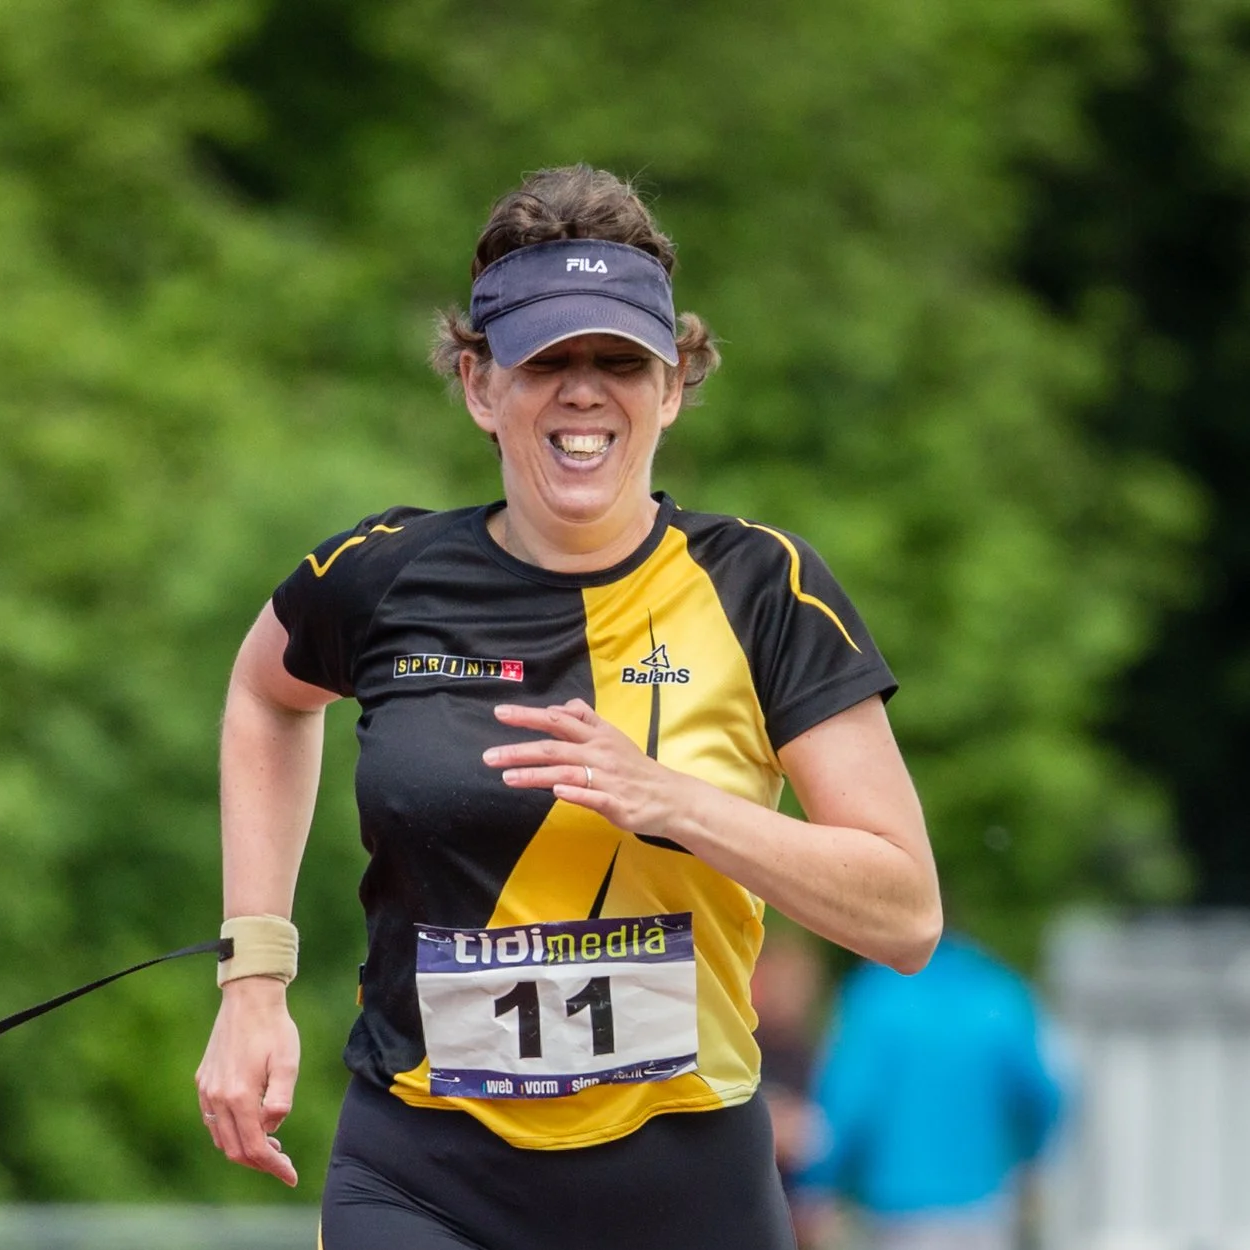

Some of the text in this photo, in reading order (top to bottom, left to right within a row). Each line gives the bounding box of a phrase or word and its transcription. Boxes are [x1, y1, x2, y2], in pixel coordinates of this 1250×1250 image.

[566, 258, 608, 274] FILA
[397, 657, 498, 676] SPRINT
[494, 975, 616, 1060] 11
[486, 1078, 514, 1094] web
[524, 1080, 559, 1095] vorm
